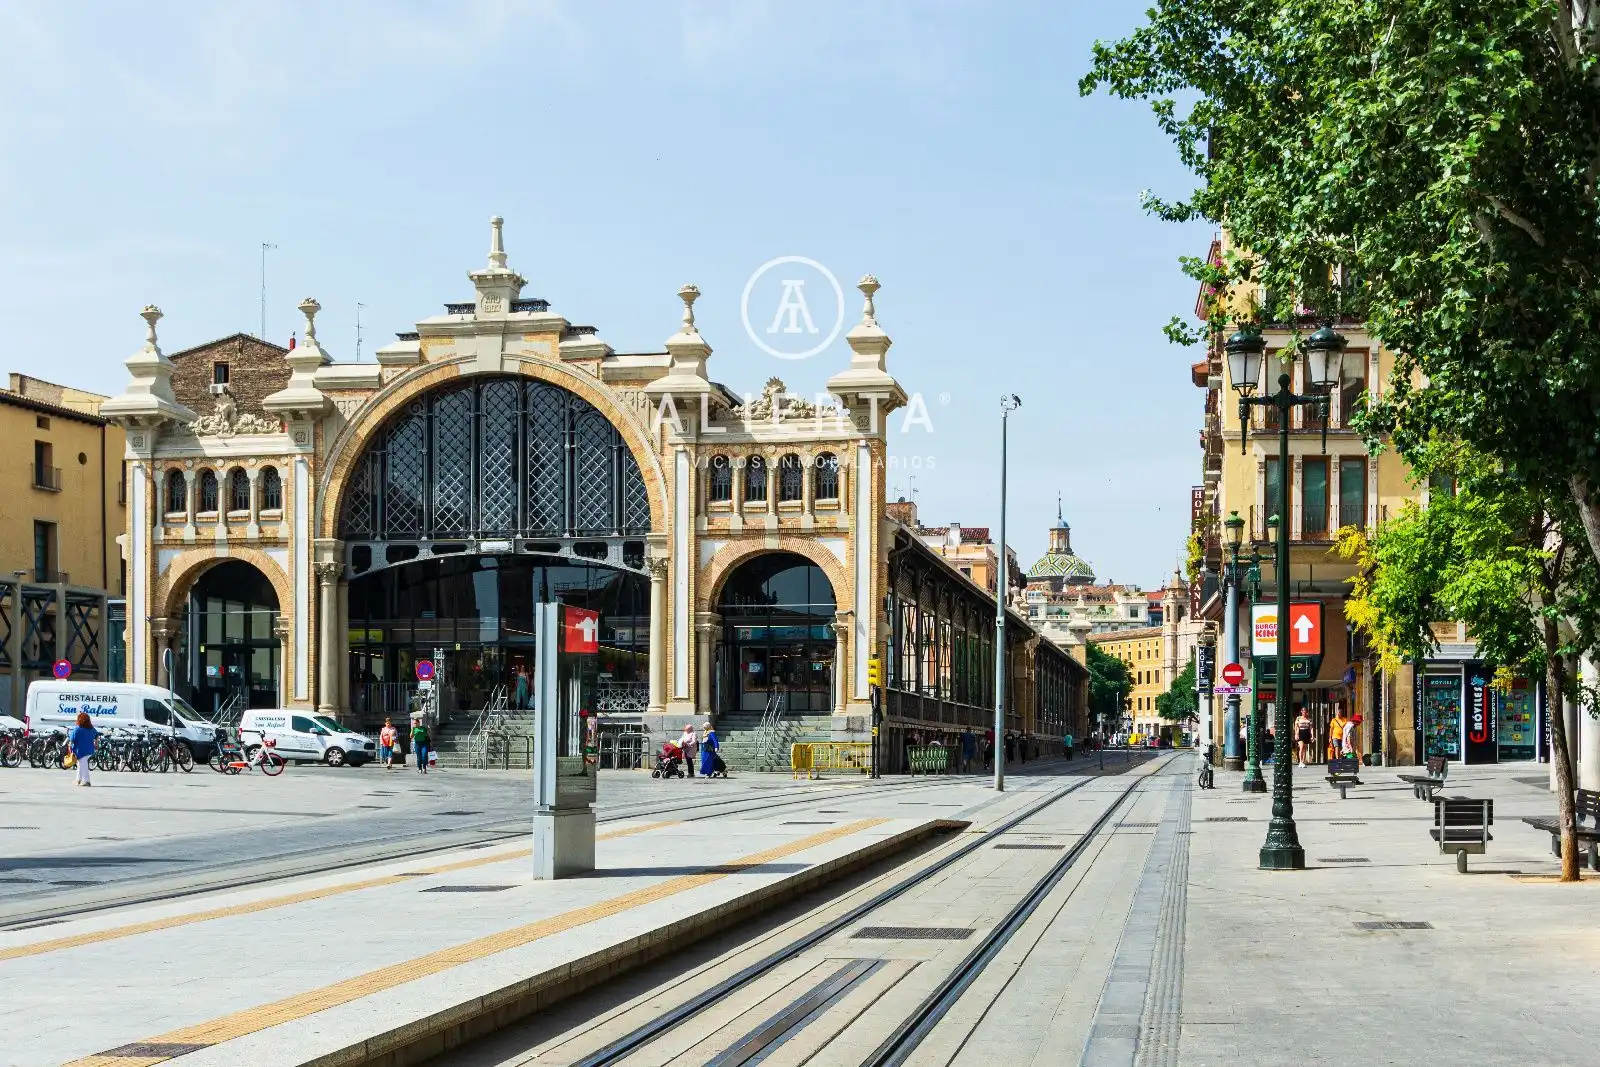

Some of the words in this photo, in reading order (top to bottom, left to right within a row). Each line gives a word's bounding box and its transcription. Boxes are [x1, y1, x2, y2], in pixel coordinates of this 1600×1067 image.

[59, 694, 118, 703] CRISTALERIA
[58, 703, 77, 714] San
[80, 703, 118, 717] Rafael
